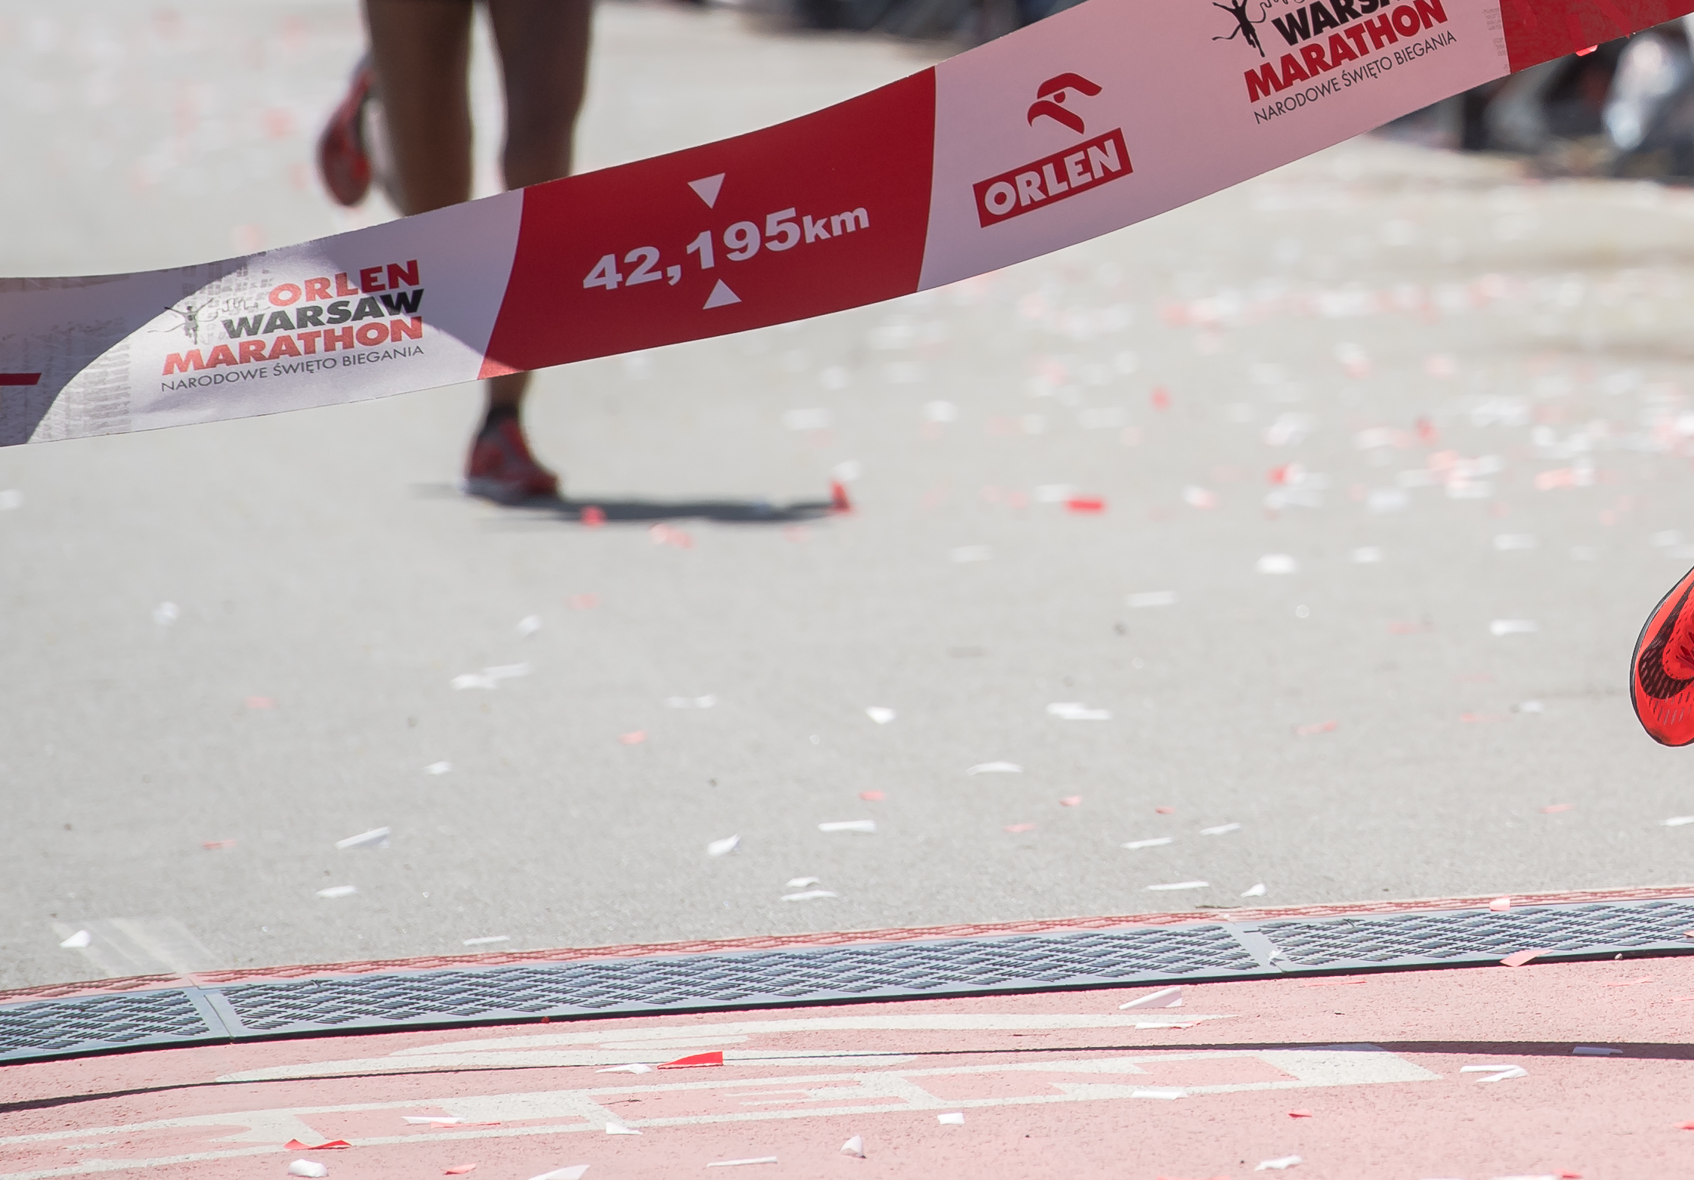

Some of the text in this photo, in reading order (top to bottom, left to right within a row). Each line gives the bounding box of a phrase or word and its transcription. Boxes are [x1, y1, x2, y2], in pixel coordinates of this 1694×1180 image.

[1254, 30, 1457, 124] NARODOWE ŚWIĘTO BIEGANIA
[985, 138, 1121, 216] ORLEN
[583, 207, 870, 290] 42,195km
[222, 288, 424, 339] WARSAW
[269, 260, 420, 307] ORLEN
[161, 345, 424, 392] NARODOWE ŚWIĘTO BIEGANIA
[162, 316, 423, 376] MARATHON
[0, 1056, 1300, 1173] RLEN
